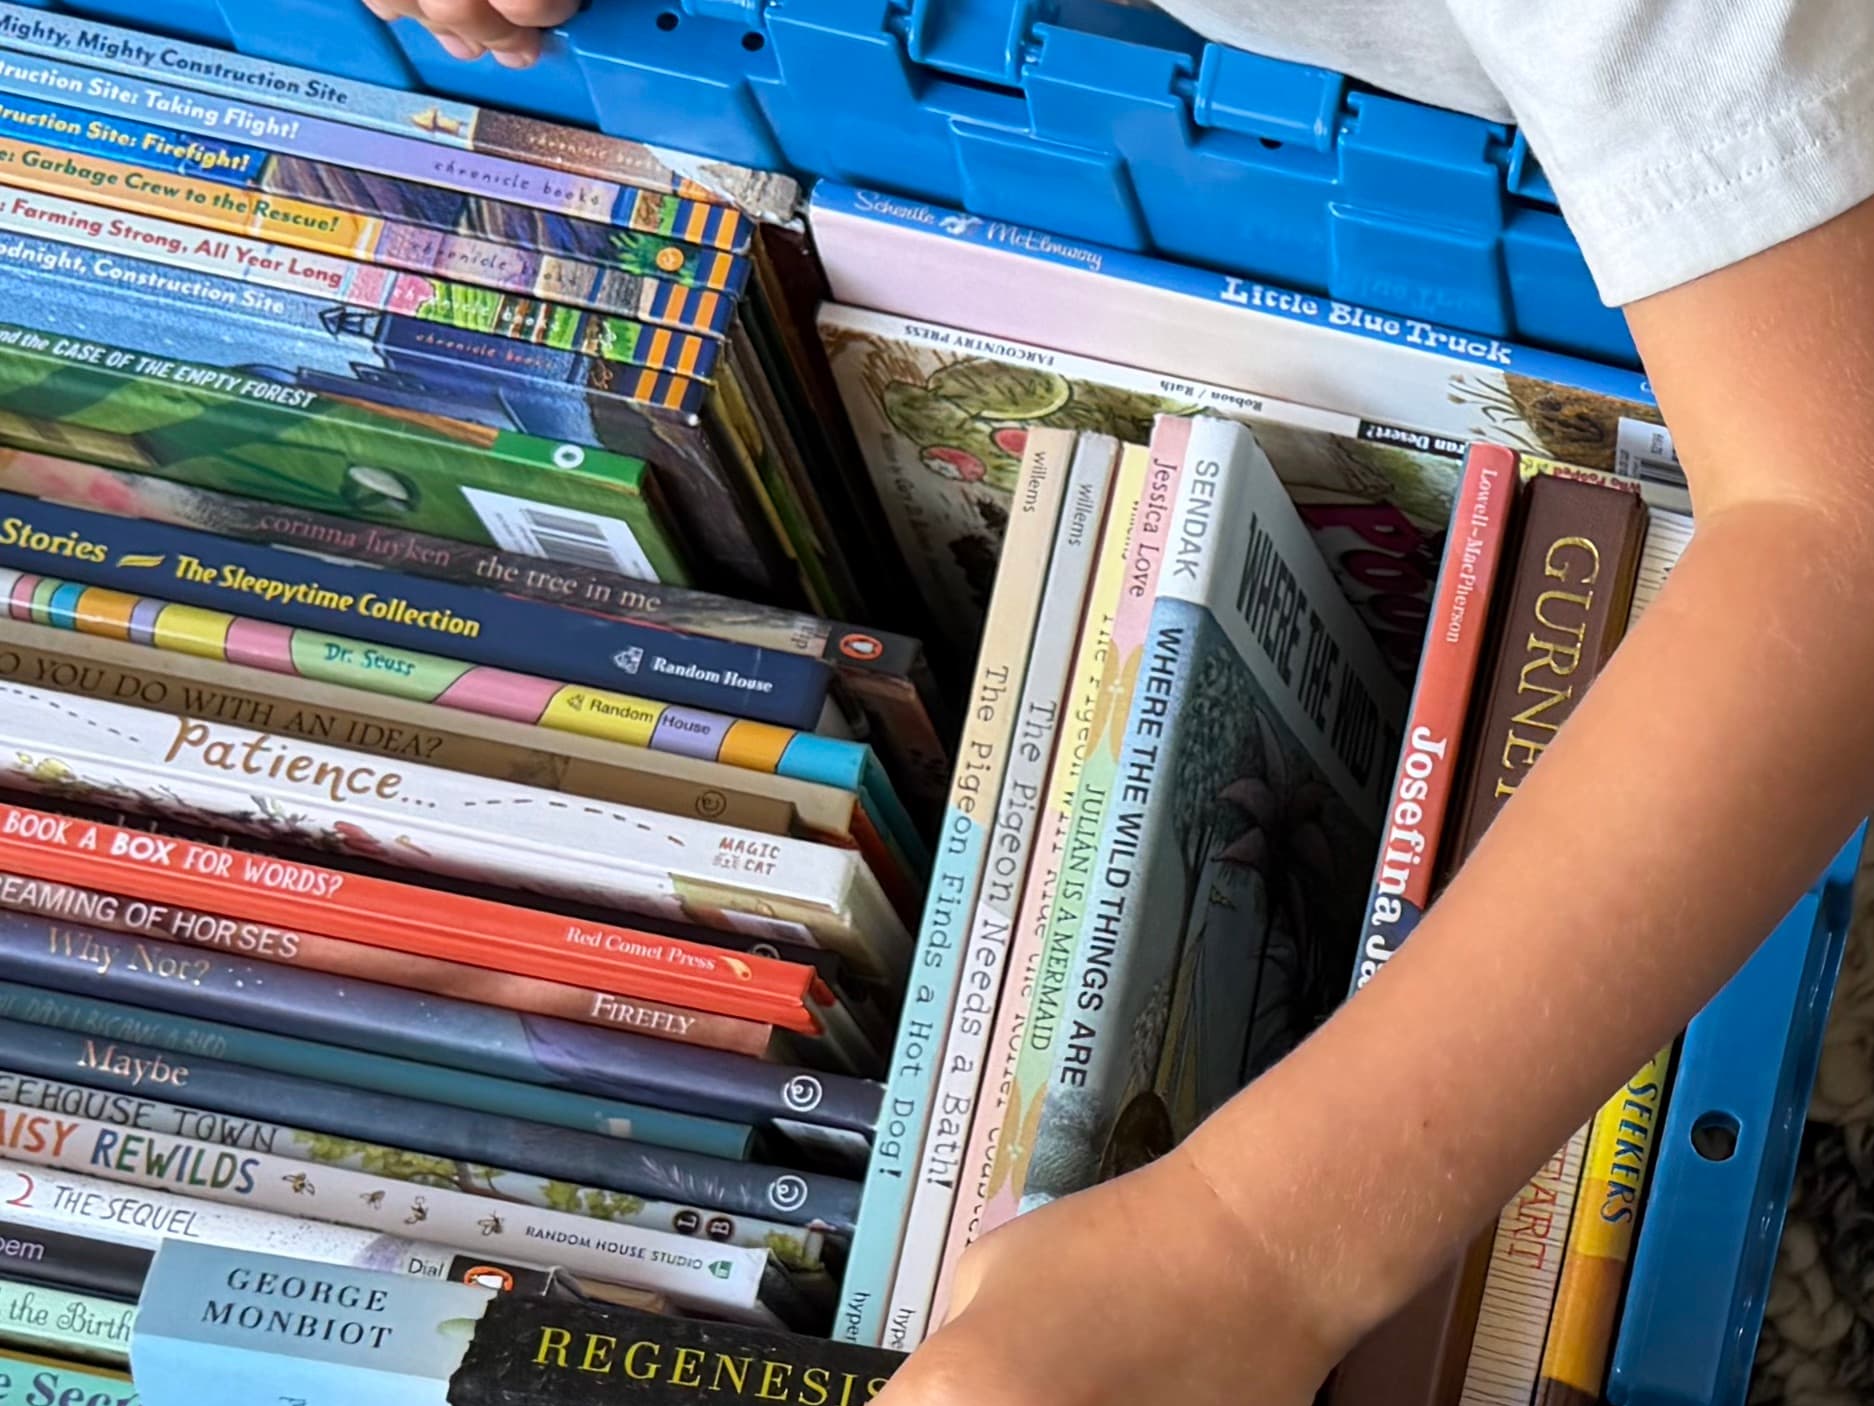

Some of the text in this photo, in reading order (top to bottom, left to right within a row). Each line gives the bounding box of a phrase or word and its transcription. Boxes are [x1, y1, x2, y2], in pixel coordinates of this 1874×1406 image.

[77, 30, 347, 104] Mighty Construction Site
[87, 78, 298, 139] Site: Taking Flight!
[21, 150, 339, 232] Garbage Crew to the Rescue!
[11, 197, 340, 289] Farming Strong, All Year Long
[1217, 277, 1511, 365] Little Blue Truck
[51, 339, 317, 408] CASE OF THE EMPTY FOREST
[1142, 457, 1177, 533] Jessica
[1172, 460, 1219, 580] SENDAK
[0, 518, 107, 562] Stories
[1127, 543, 1159, 597] Love
[176, 555, 479, 637] The Sleepytime Collection
[476, 556, 661, 613] the tree in me
[323, 642, 415, 676] Dr. Seuss
[2, 810, 343, 898] BOOK A BOX FOR WORDS?
[1059, 628, 1183, 1087] WHERE THE WILD THINGS ARE
[1370, 726, 1445, 925] Josefina
[877, 665, 1008, 1178] The Pigeon Finds a Hot Dog!
[591, 993, 696, 1034] FIREFLY
[74, 1042, 188, 1087] Maybe
[89, 1128, 259, 1195] REWILDS
[169, 1105, 278, 1152] TOWN
[53, 1179, 198, 1237] THE SEQUEL
[202, 1300, 392, 1348] MONBIOT
[227, 1268, 387, 1312] GEORGE
